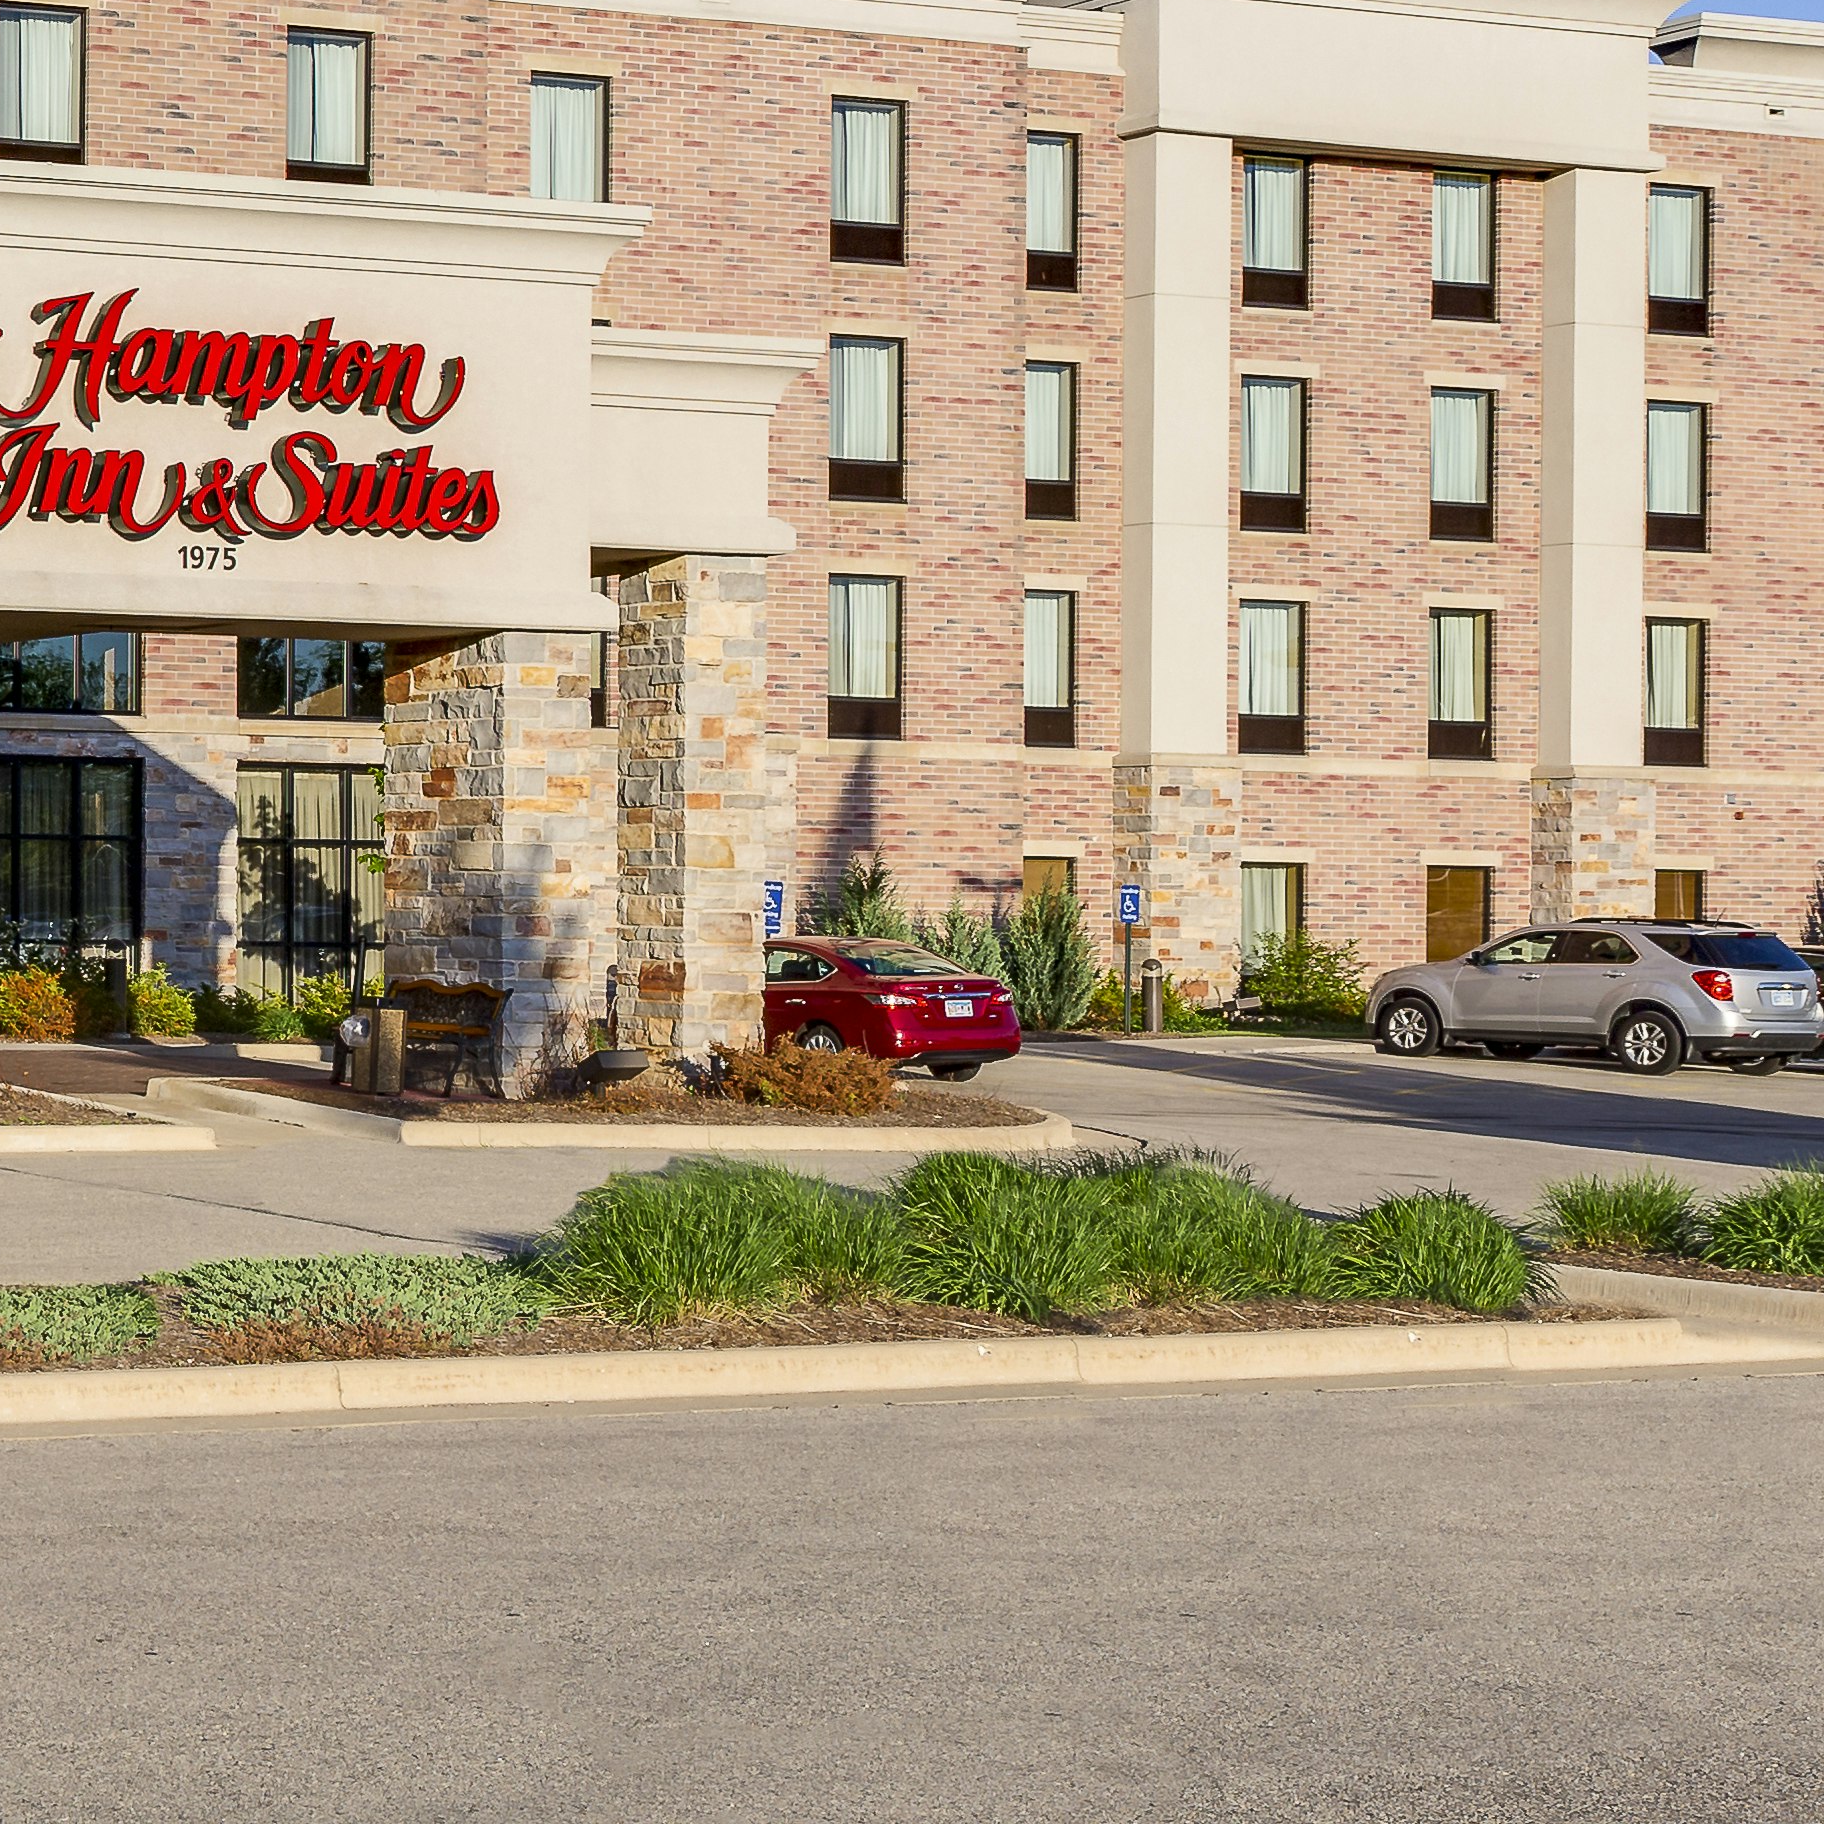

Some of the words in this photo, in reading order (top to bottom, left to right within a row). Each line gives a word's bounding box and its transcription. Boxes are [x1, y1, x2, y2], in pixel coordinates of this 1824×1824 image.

[178, 458, 252, 544] &
[236, 431, 499, 542] Suites
[178, 545, 237, 571] 1975
